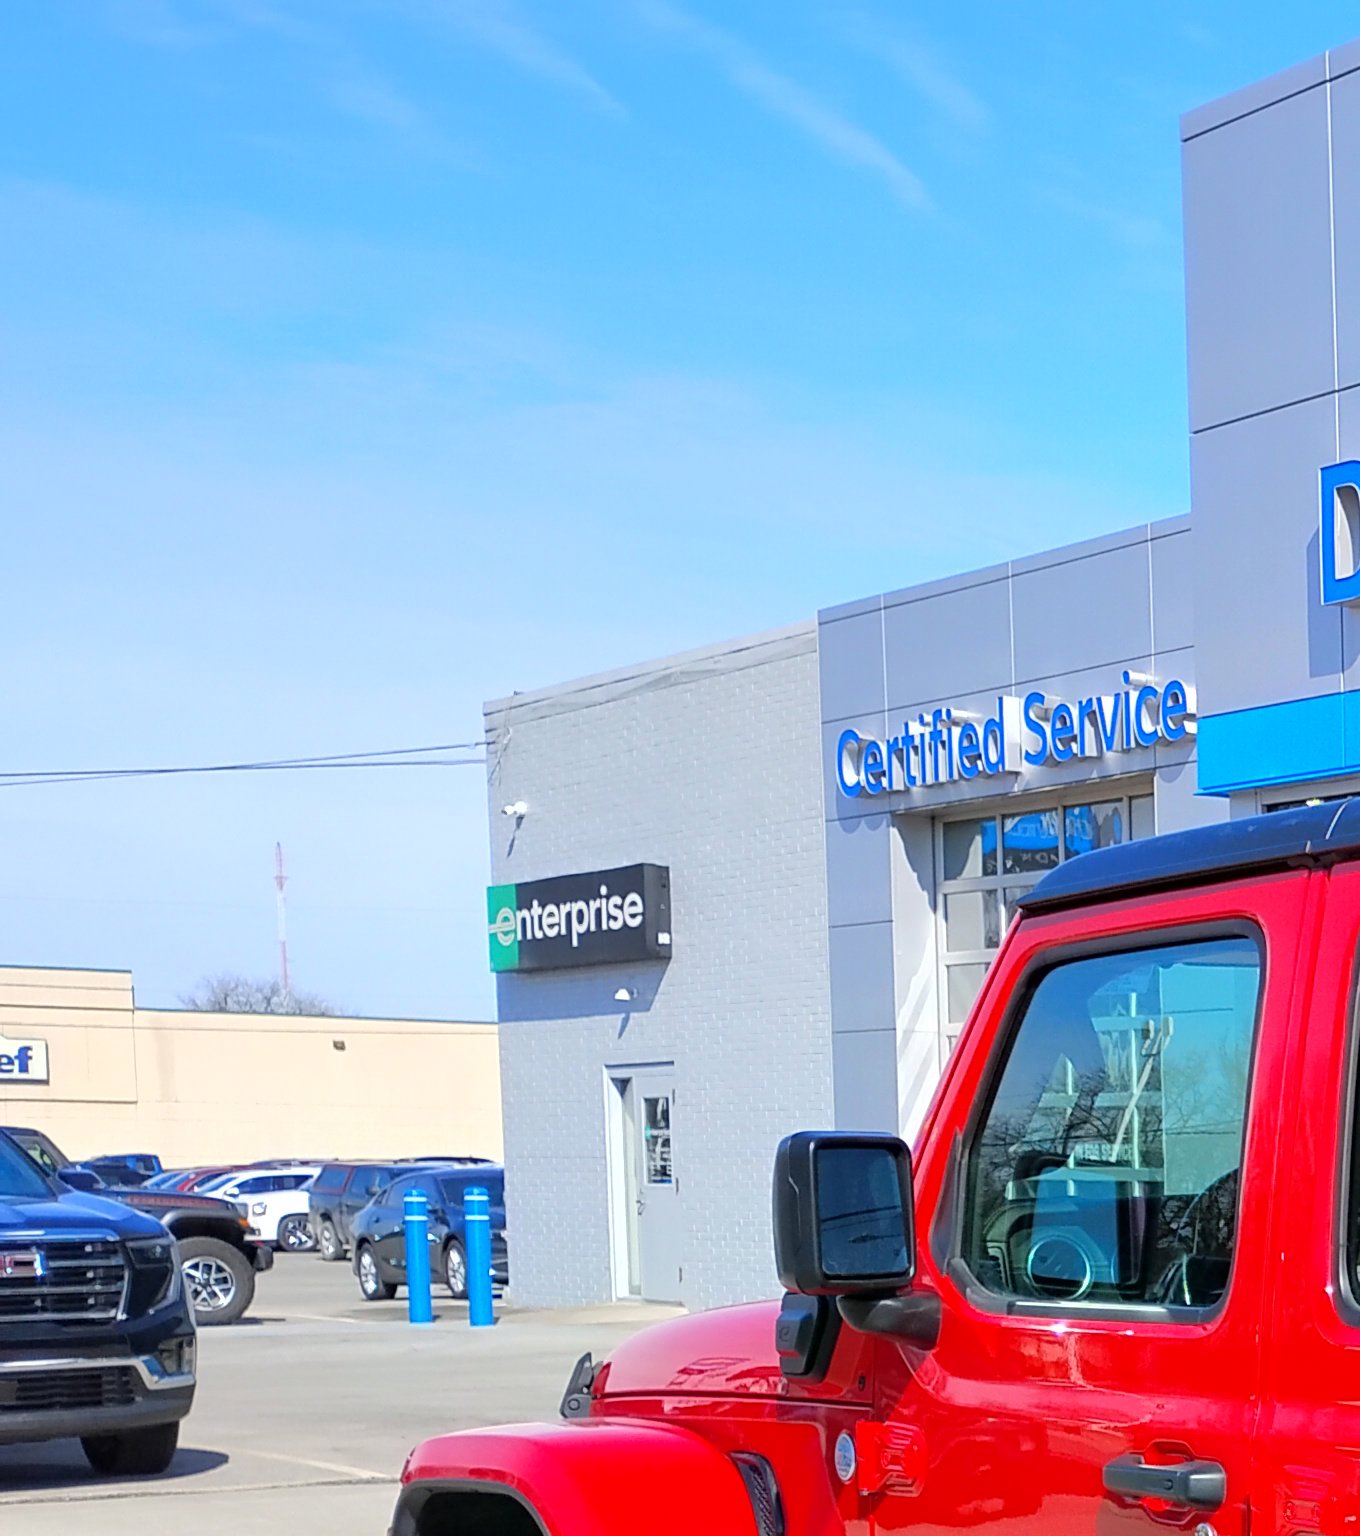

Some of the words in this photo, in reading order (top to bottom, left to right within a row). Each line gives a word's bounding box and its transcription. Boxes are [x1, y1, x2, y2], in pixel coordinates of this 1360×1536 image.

[837, 697, 1012, 798] Certified
[1023, 671, 1190, 767] Service
[490, 885, 644, 948] enterprise
